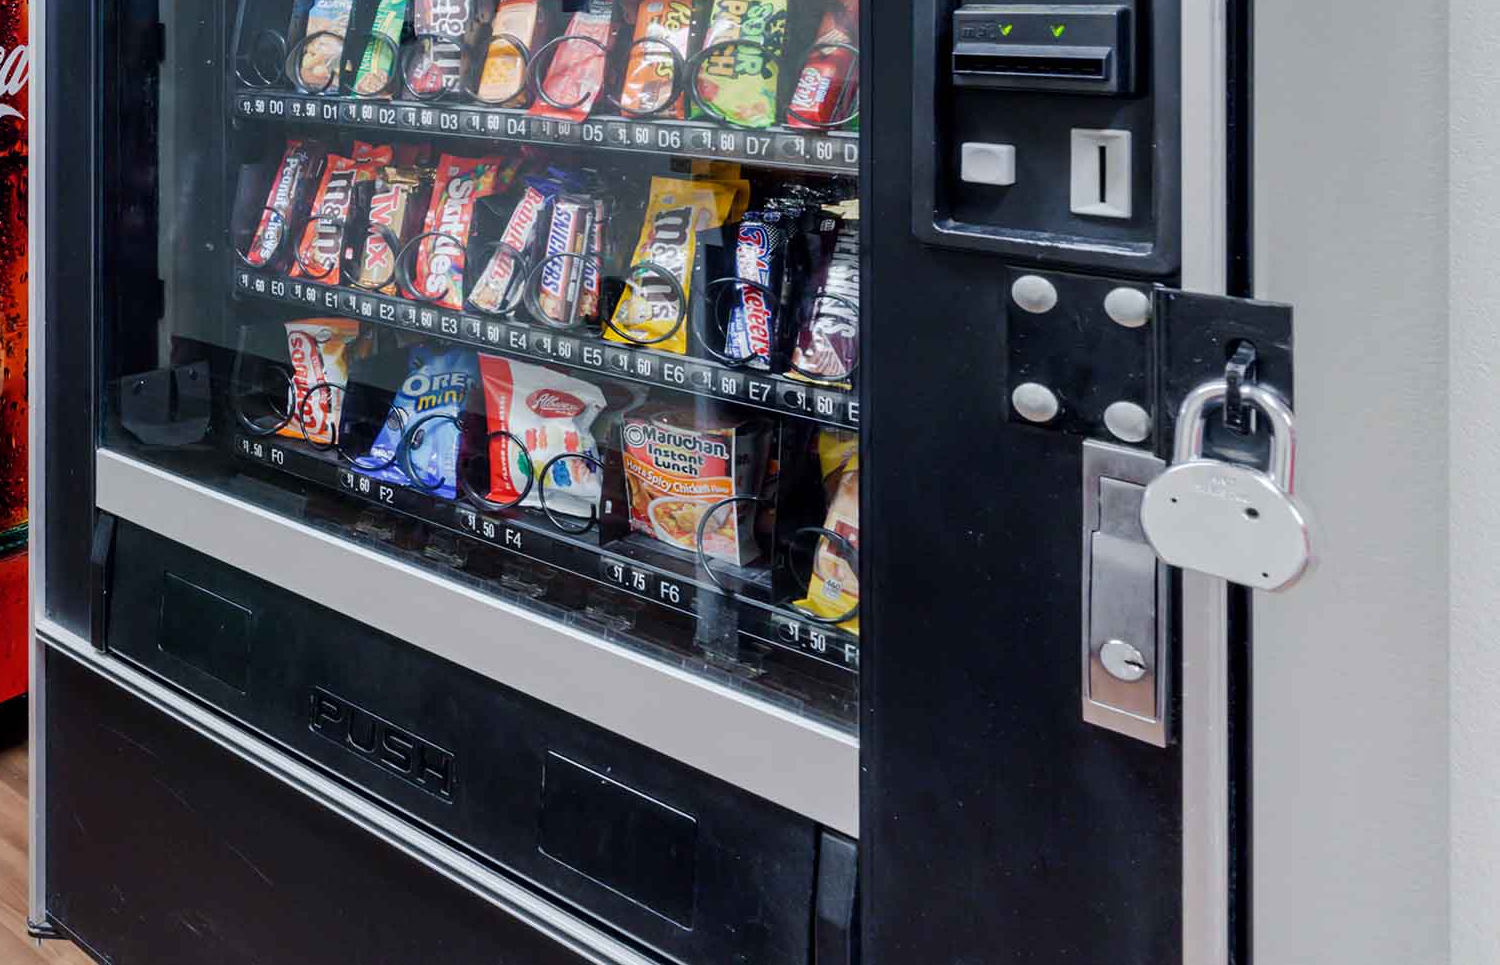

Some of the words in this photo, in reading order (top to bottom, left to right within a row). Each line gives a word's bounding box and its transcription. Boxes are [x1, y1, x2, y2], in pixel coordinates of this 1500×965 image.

[270, 101, 283, 115] D0
[323, 104, 338, 120] D1
[379, 108, 395, 124] D2
[441, 112, 457, 129] D3
[508, 119, 526, 135] D4
[583, 124, 603, 142] D5
[658, 130, 681, 149] D6
[747, 136, 770, 156] D7
[425, 177, 474, 294] Skittles
[541, 202, 573, 295] SNICKERS
[271, 281, 284, 296] E0
[325, 293, 338, 309] E1
[738, 249, 771, 364] Mketeers
[380, 304, 395, 321] E2
[442, 317, 457, 334] E3
[509, 332, 527, 350] E4
[583, 348, 602, 366] E5
[664, 364, 684, 384] E6
[417, 388, 464, 412] mini
[749, 381, 771, 402] E7
[643, 424, 729, 460] Maruchan
[271, 448, 284, 465] F0
[647, 444, 706, 467] Instant
[653, 457, 699, 476] Lunch
[646, 470, 673, 493] Spicy
[379, 486, 394, 504] F2
[505, 529, 522, 548] F4
[660, 583, 680, 603] F6
[311, 696, 450, 796] PUSH
